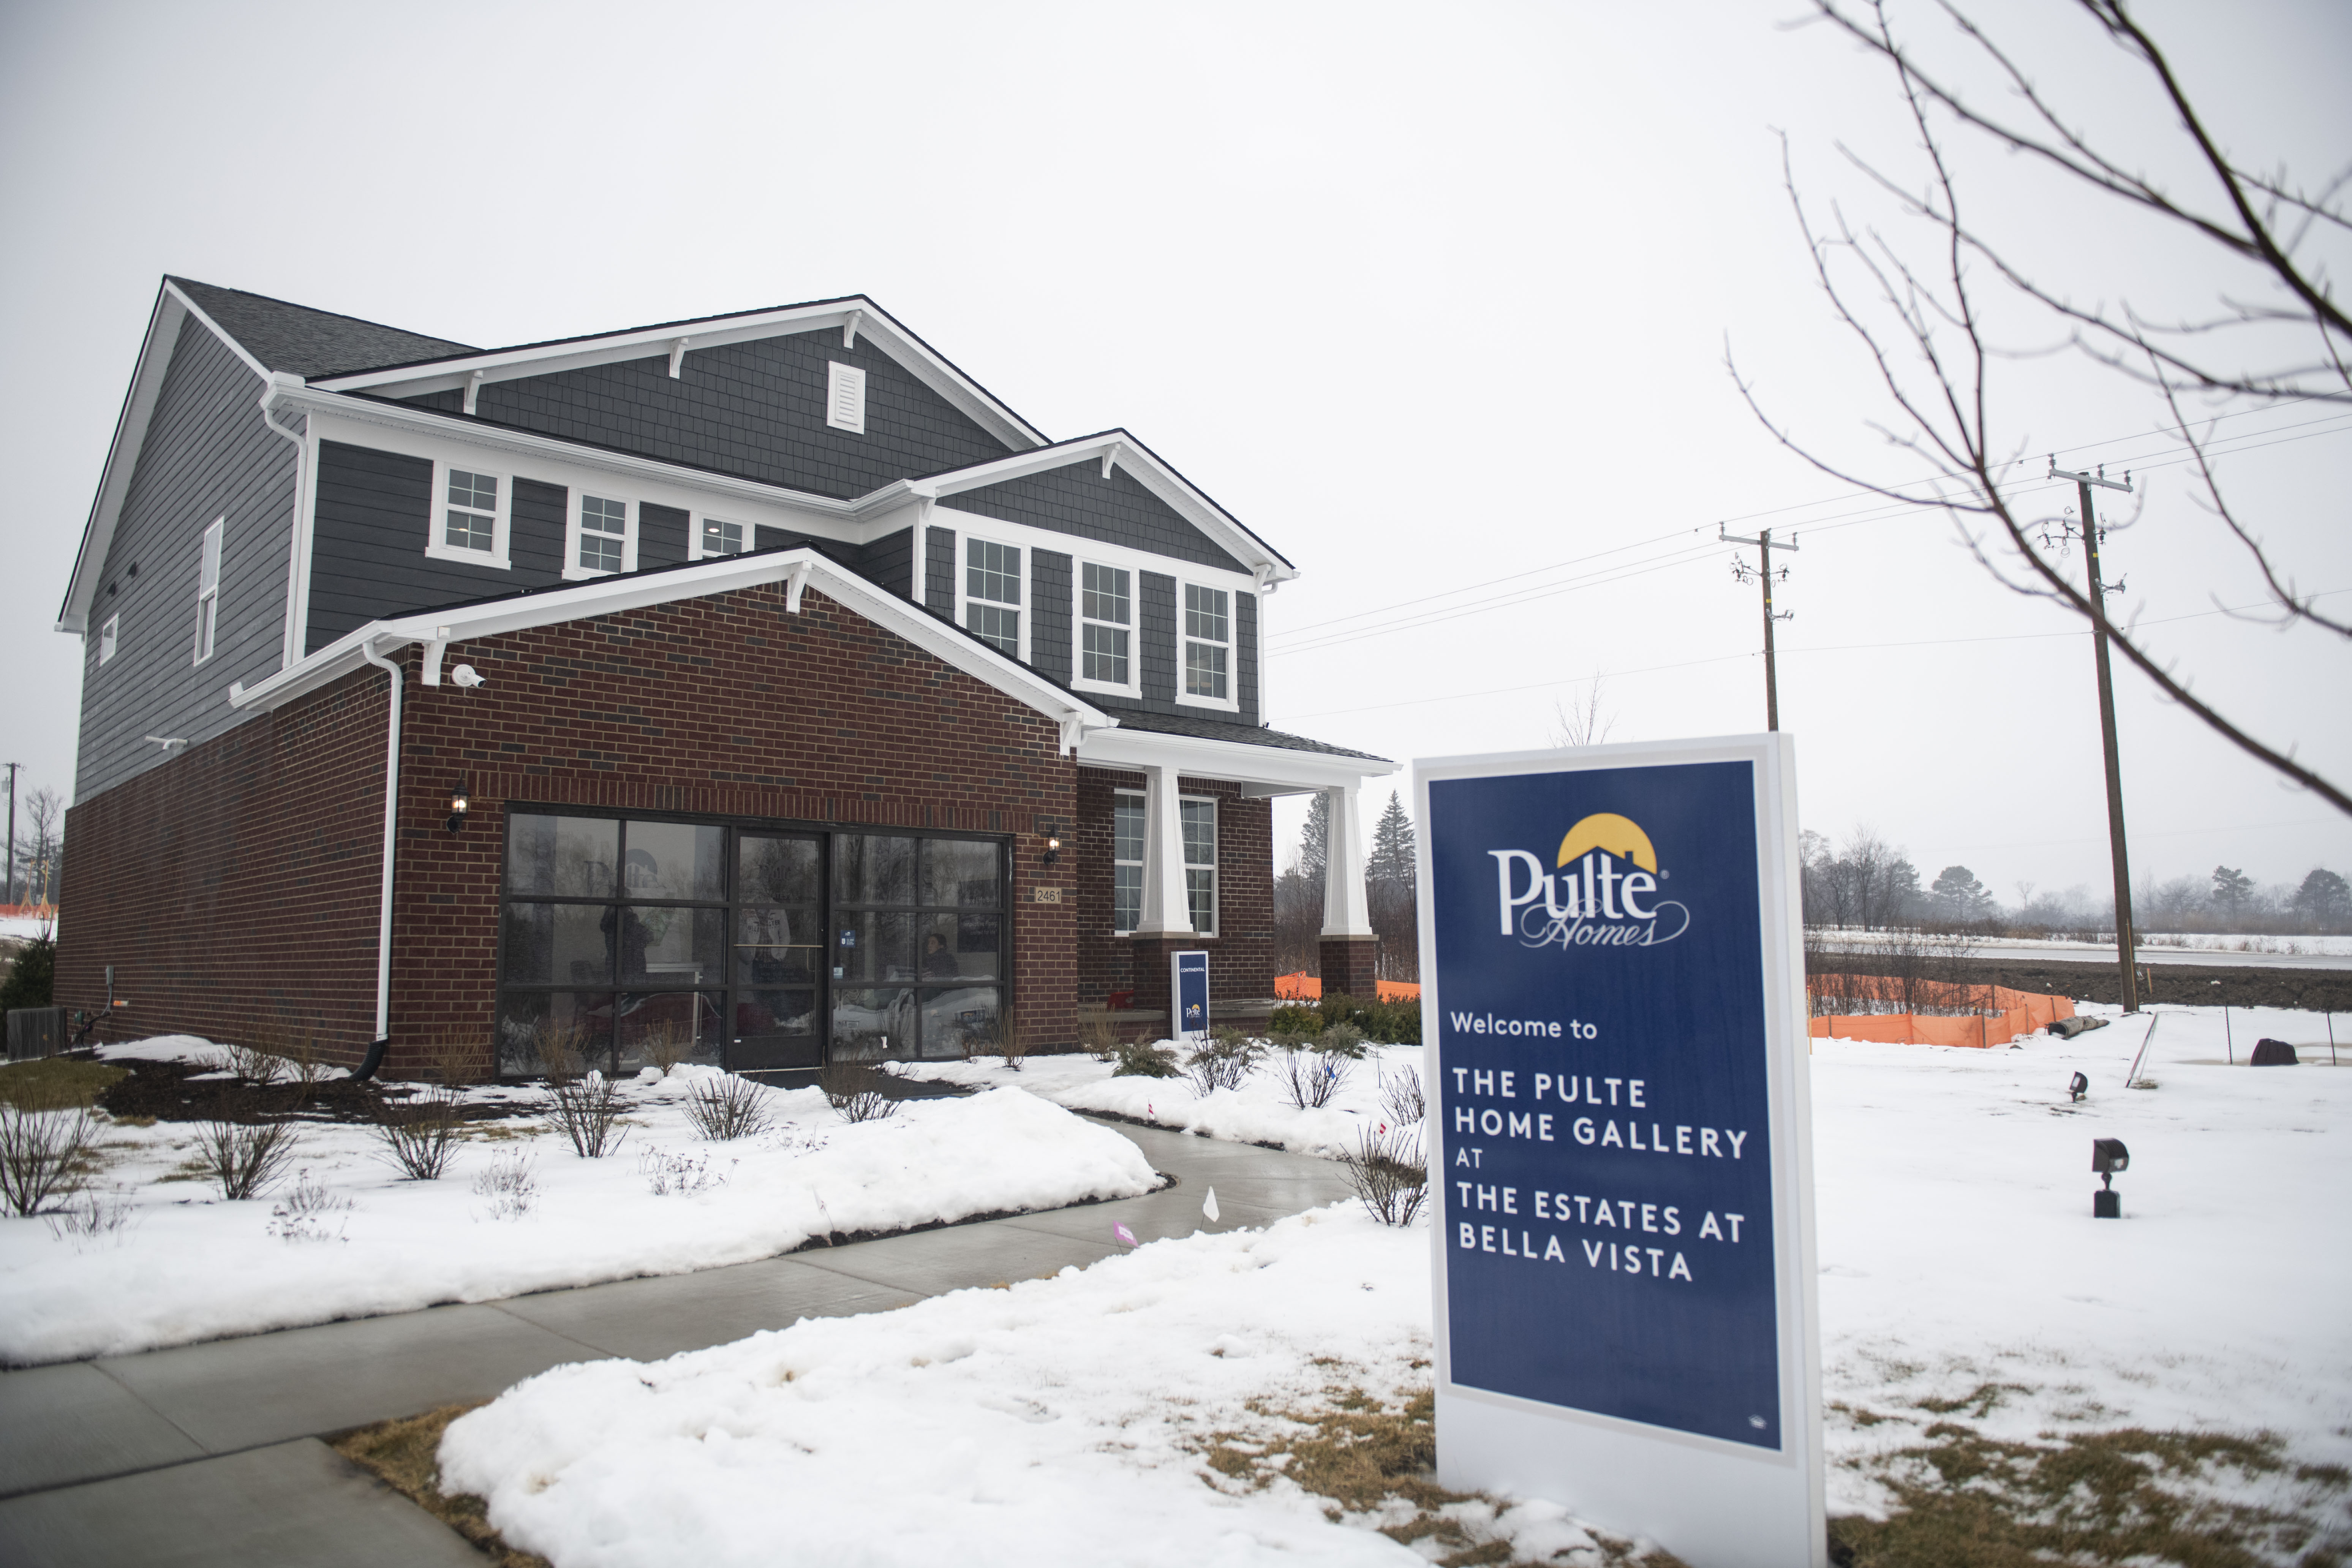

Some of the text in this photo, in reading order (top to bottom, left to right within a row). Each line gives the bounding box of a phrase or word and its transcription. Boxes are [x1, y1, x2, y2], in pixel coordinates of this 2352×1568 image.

[1038, 890, 1059, 901] 2461
[1487, 850, 1657, 936] Pulte
[1520, 899, 1690, 951] Homes
[1186, 1007, 1200, 1018] Pulte
[1450, 1011, 1597, 1040] Welcome to
[1453, 1067, 1646, 1108] THE PULTE
[1455, 1106, 1747, 1159] HOME GALLERY
[1456, 1147, 1483, 1169] AT
[1456, 1181, 1745, 1243] THE ESTATES AT
[1459, 1222, 1693, 1282] BELLA VISTA
